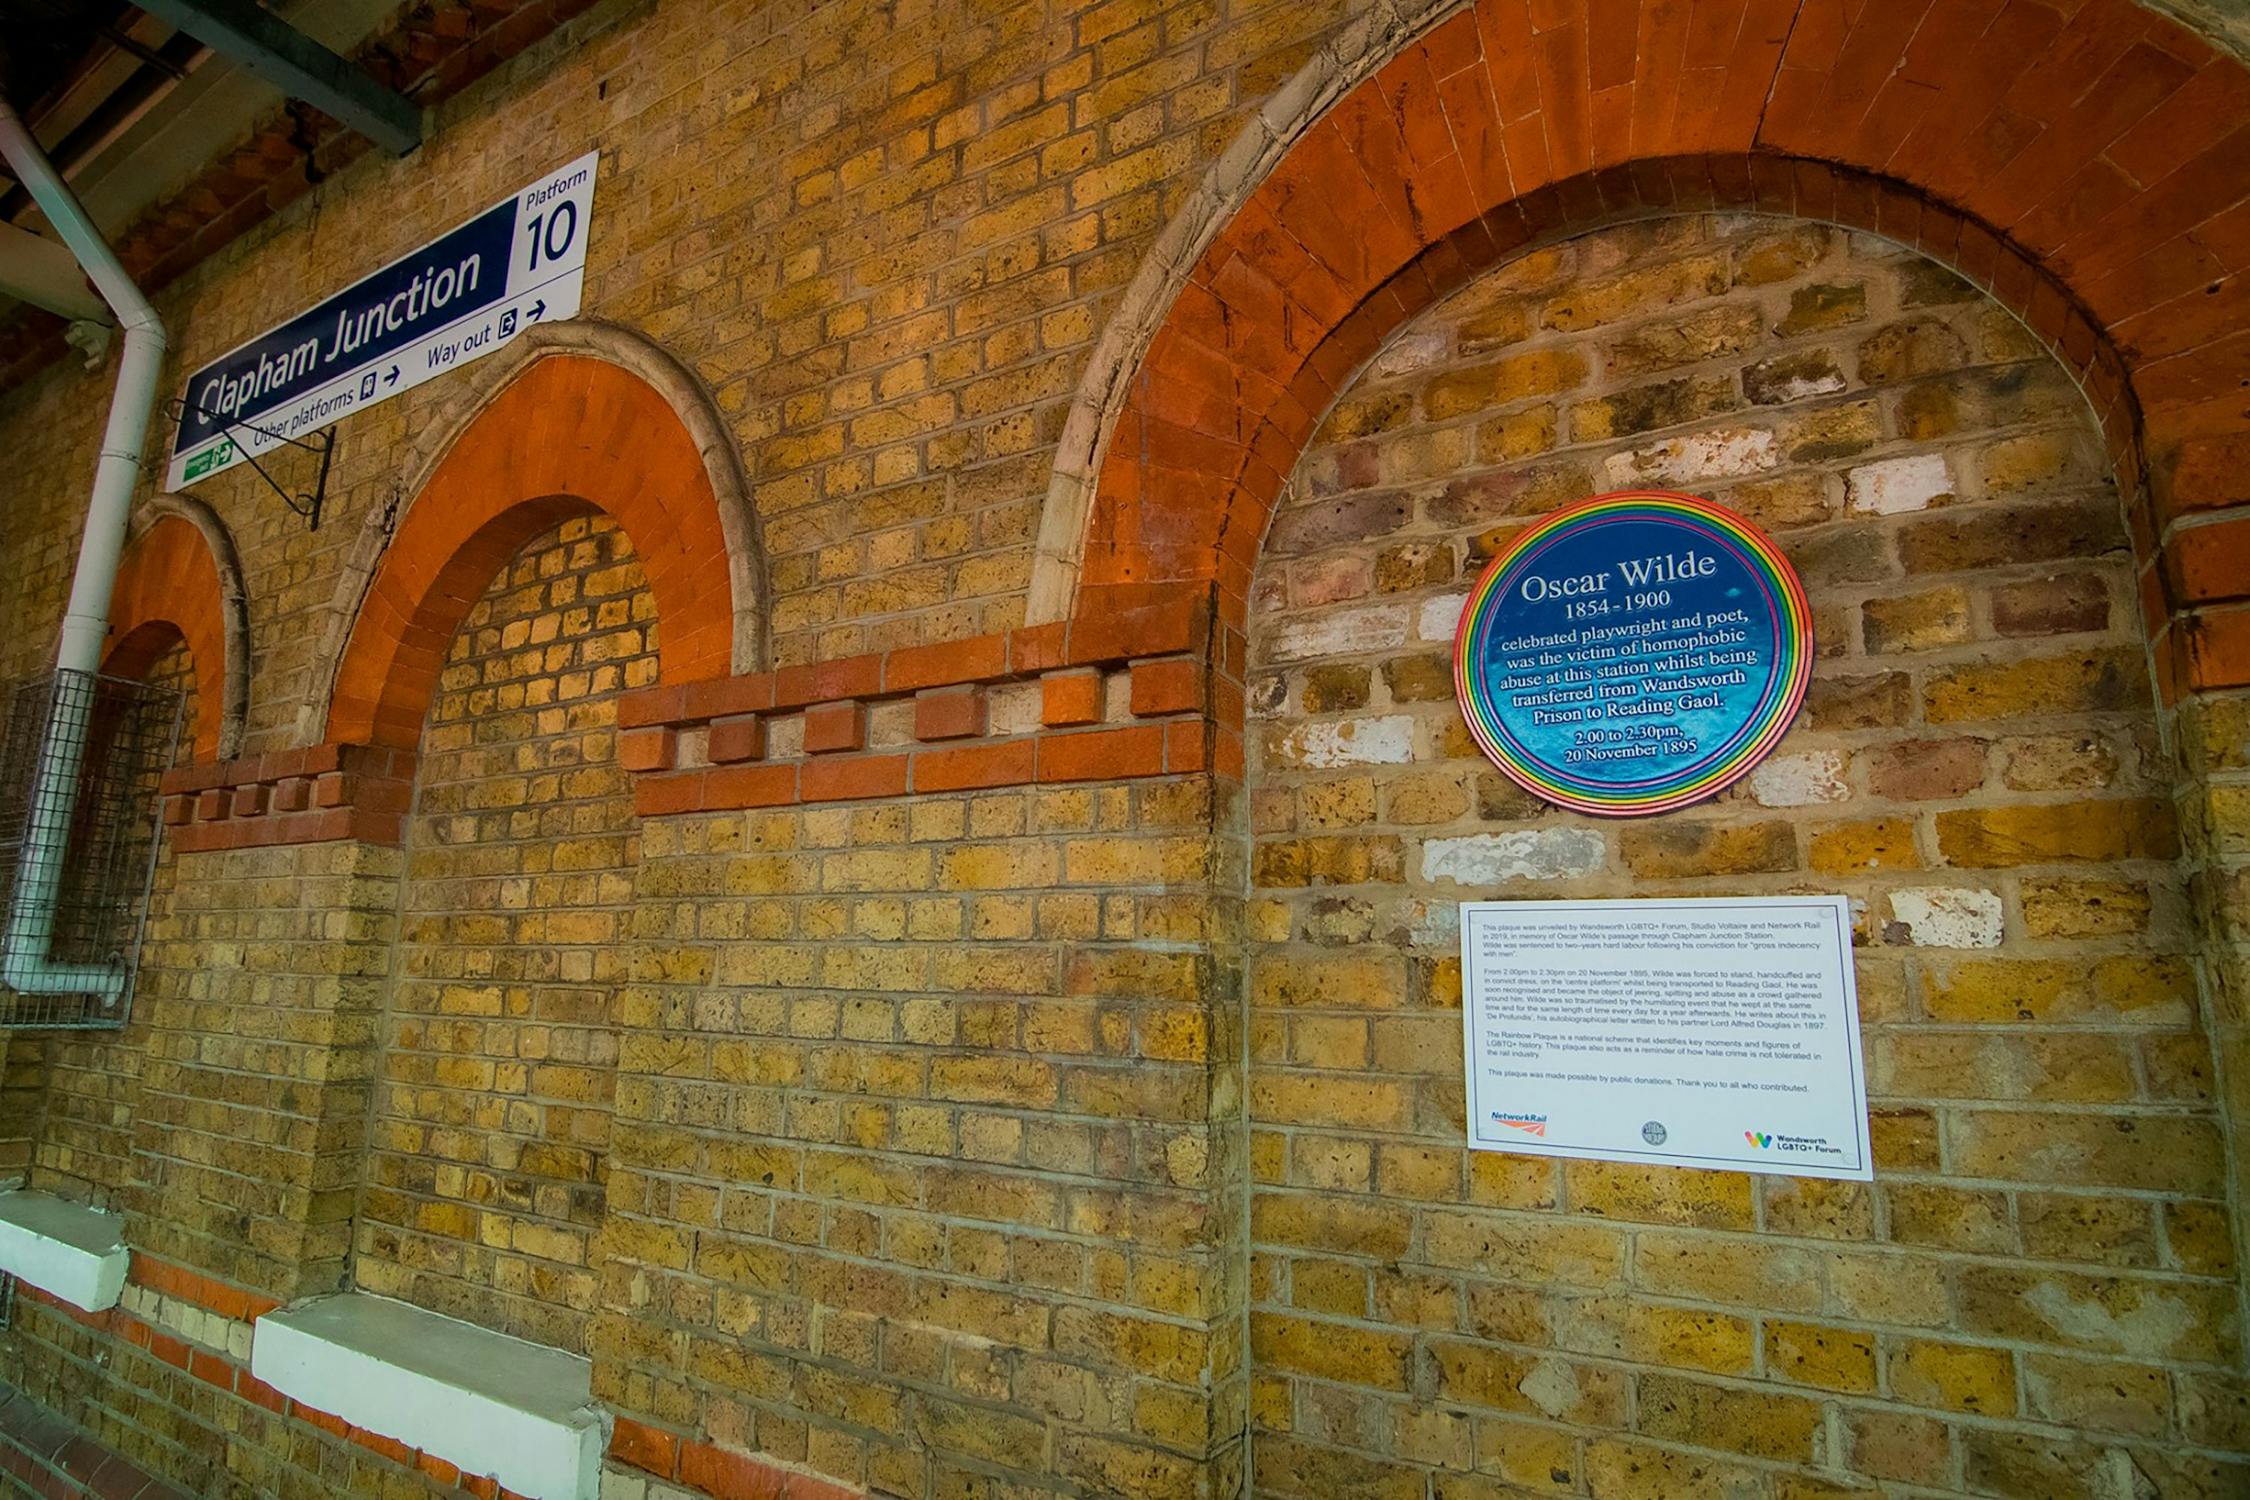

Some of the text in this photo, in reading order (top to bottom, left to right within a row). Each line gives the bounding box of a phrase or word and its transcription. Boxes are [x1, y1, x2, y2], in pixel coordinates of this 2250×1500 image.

[525, 168, 587, 211] Platform
[528, 200, 576, 272] 10
[198, 252, 480, 424] Clapham Junction
[427, 324, 492, 369] Way out
[254, 388, 354, 446] Other platforms
[1521, 551, 1716, 602] Oscar Wilde
[1502, 610, 1748, 651] celebrated playwright and poet,
[1507, 630, 1745, 669] was the victim of homophobic
[1500, 650, 1758, 690] abuse at this station whilst being
[1512, 670, 1746, 708] transferred from Wandsworth
[1533, 692, 1724, 724] Prison to Reading Gaol.
[1564, 740, 1697, 762] 20 November 1895
[1575, 725, 1684, 744] 2.00 to 2.30pm,
[1776, 1134, 1826, 1144] Wandsworth
[1777, 1143, 1842, 1154] LGBTQ+ Forum
